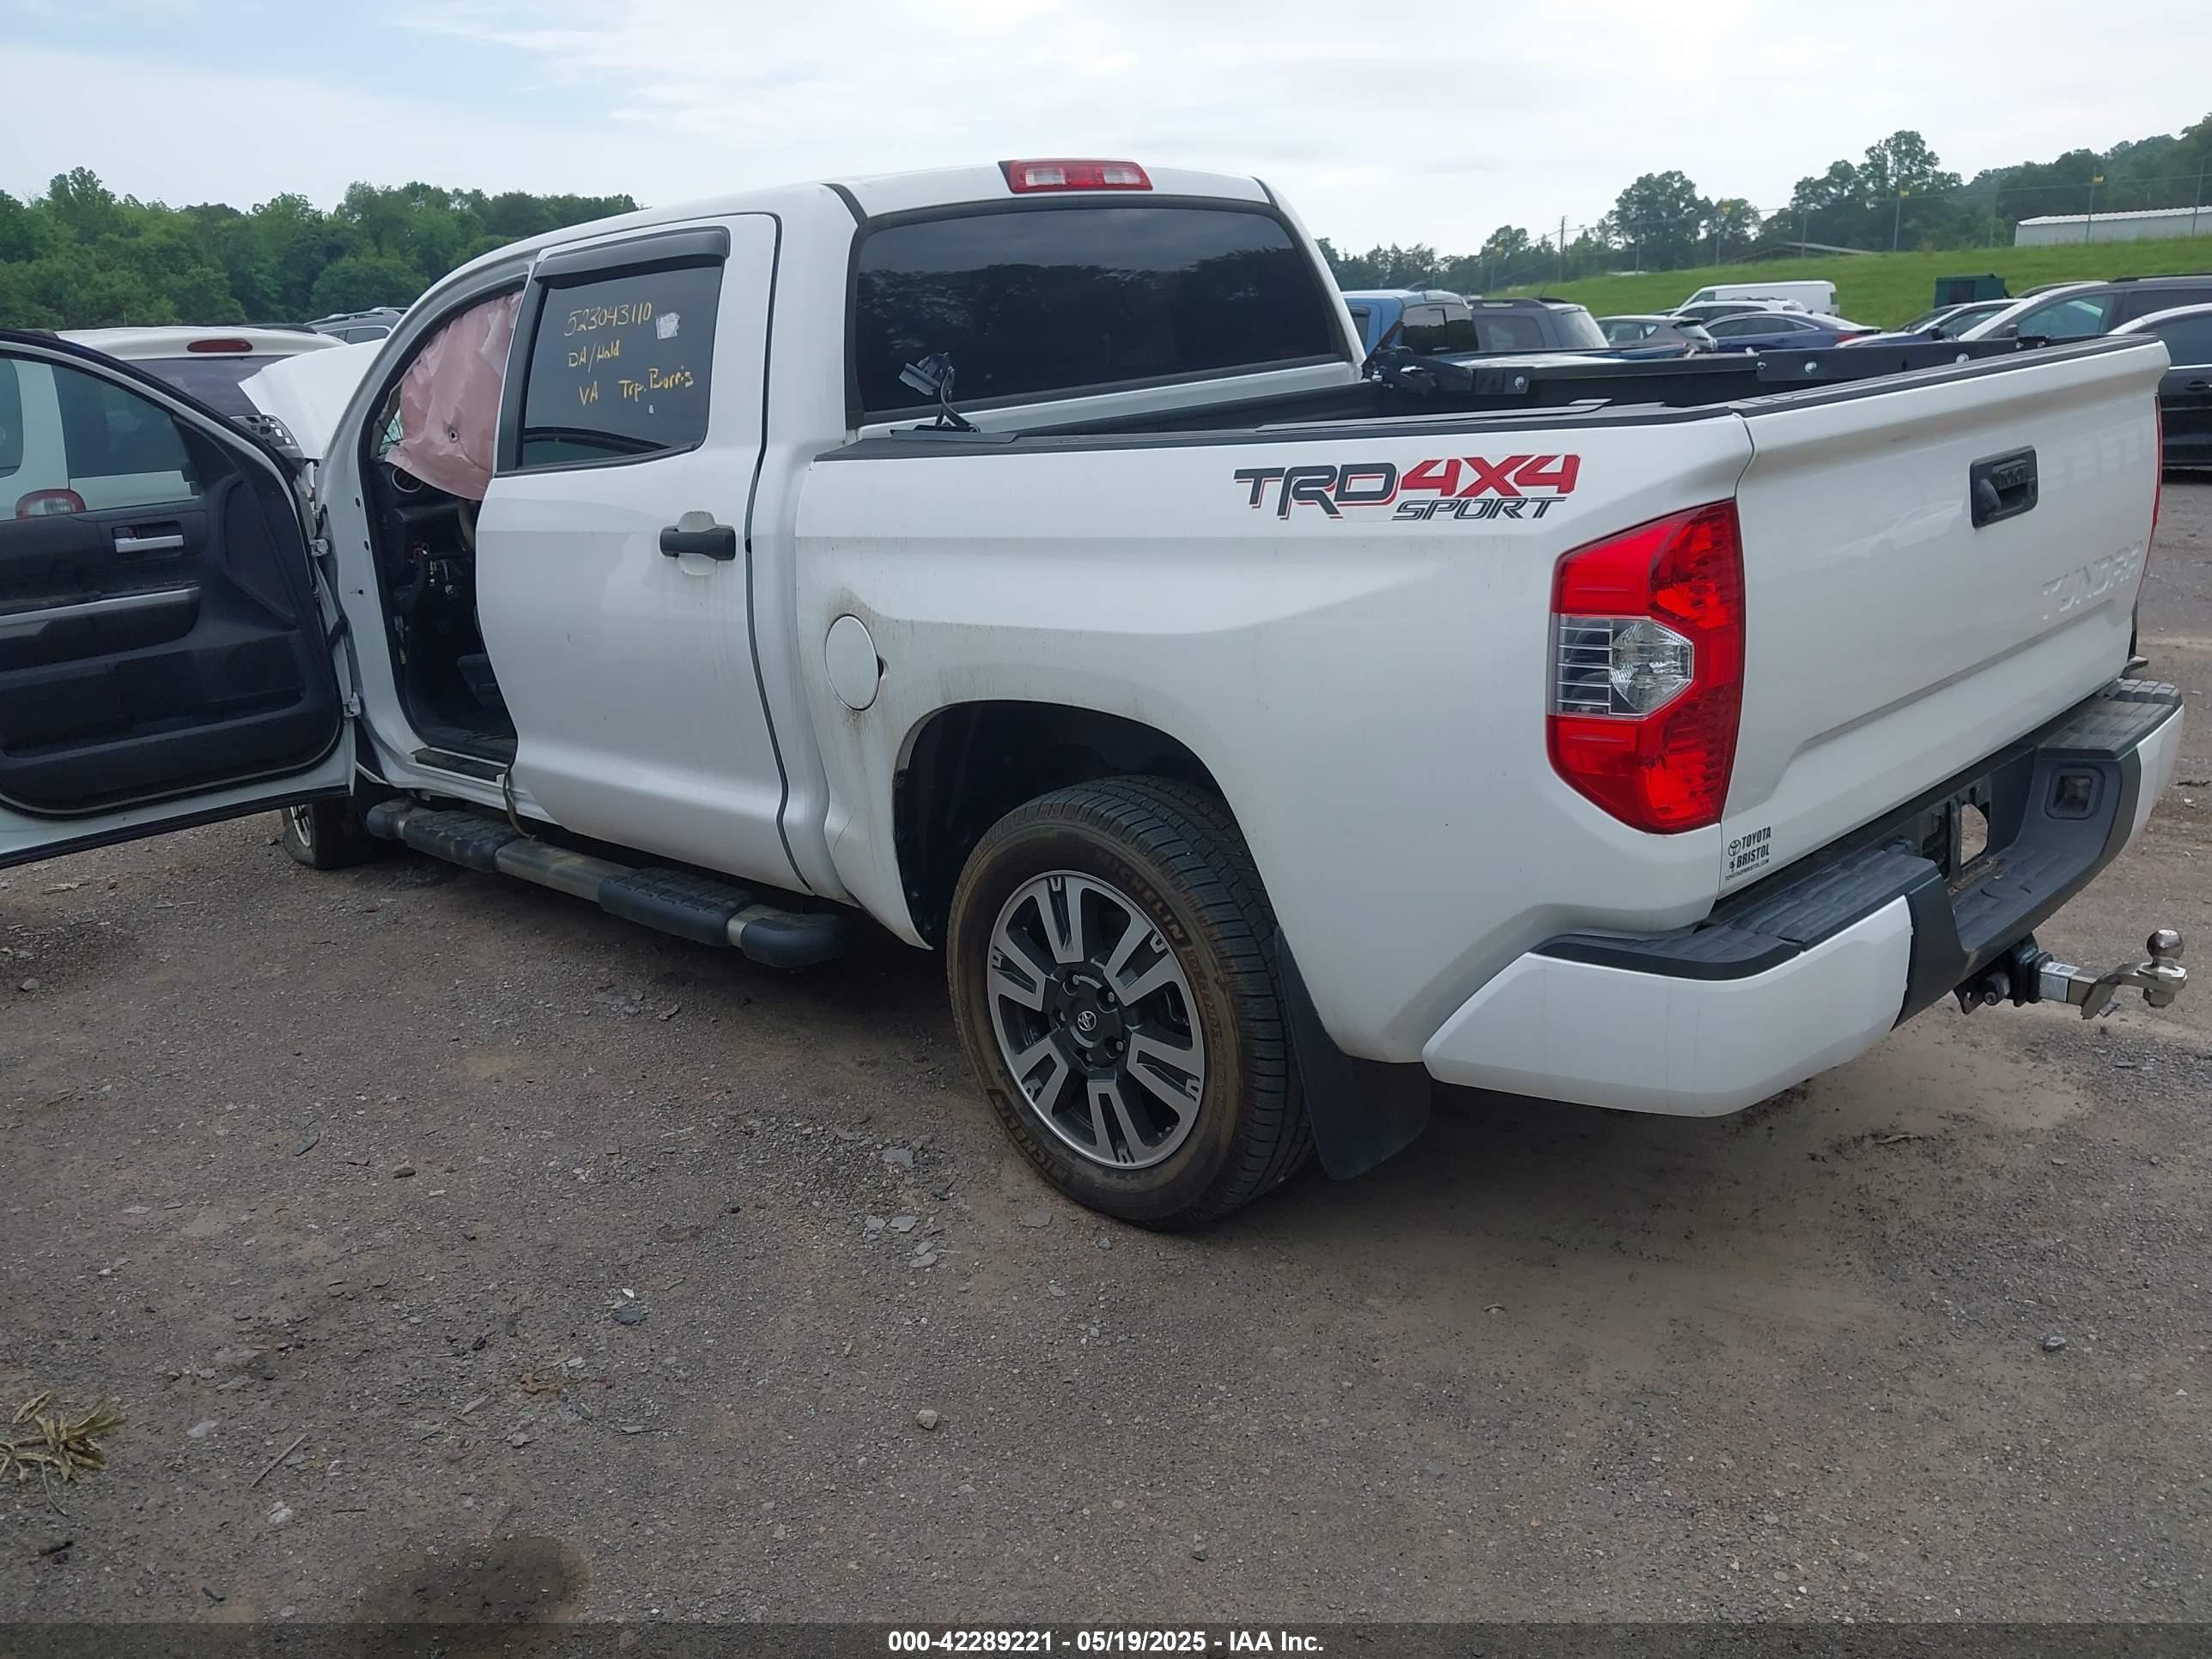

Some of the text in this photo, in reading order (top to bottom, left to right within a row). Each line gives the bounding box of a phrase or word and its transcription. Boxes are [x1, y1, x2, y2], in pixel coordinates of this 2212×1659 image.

[564, 302, 652, 337] 523043110
[579, 380, 599, 405] VA
[1234, 462, 1399, 520] TRD
[1391, 496, 1566, 521] SPORT
[1741, 826, 1771, 850] TOYOTA
[1736, 843, 1770, 869] BRISTOL
